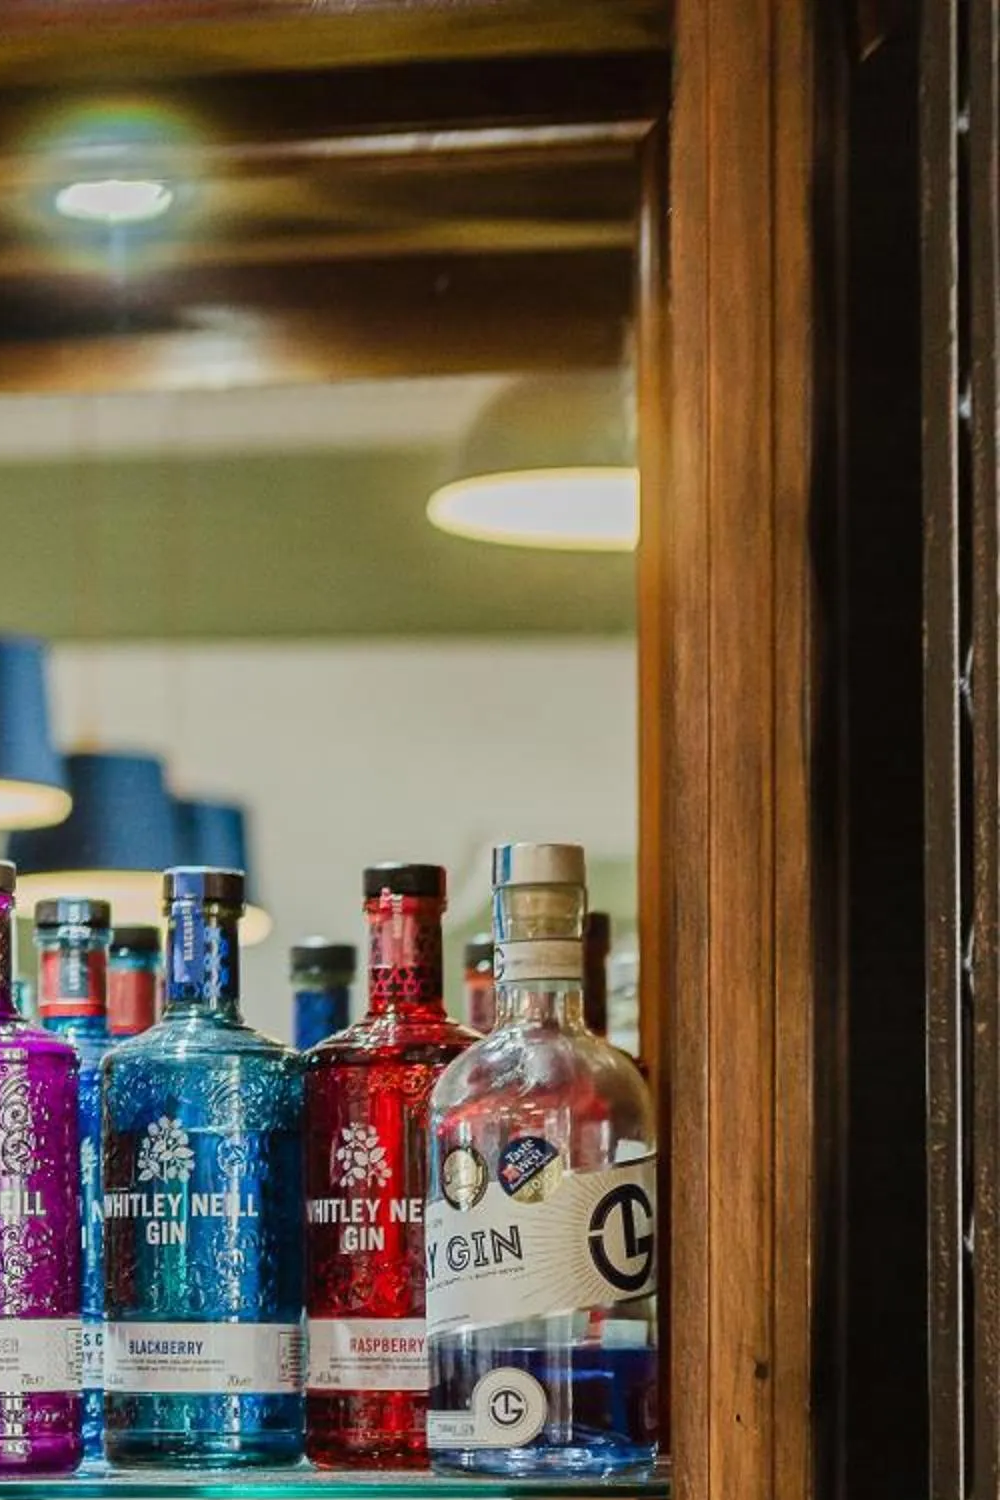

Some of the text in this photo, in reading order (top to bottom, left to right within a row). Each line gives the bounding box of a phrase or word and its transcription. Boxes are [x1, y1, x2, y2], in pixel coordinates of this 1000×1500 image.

[104, 1193, 259, 1217] WHITLEY NEILL
[146, 1220, 186, 1245] GIN
[344, 1226, 386, 1251] GIN
[446, 1224, 523, 1272] GIN
[128, 1340, 204, 1355] BLACKBERRY
[349, 1337, 426, 1353] RASPBERRY
